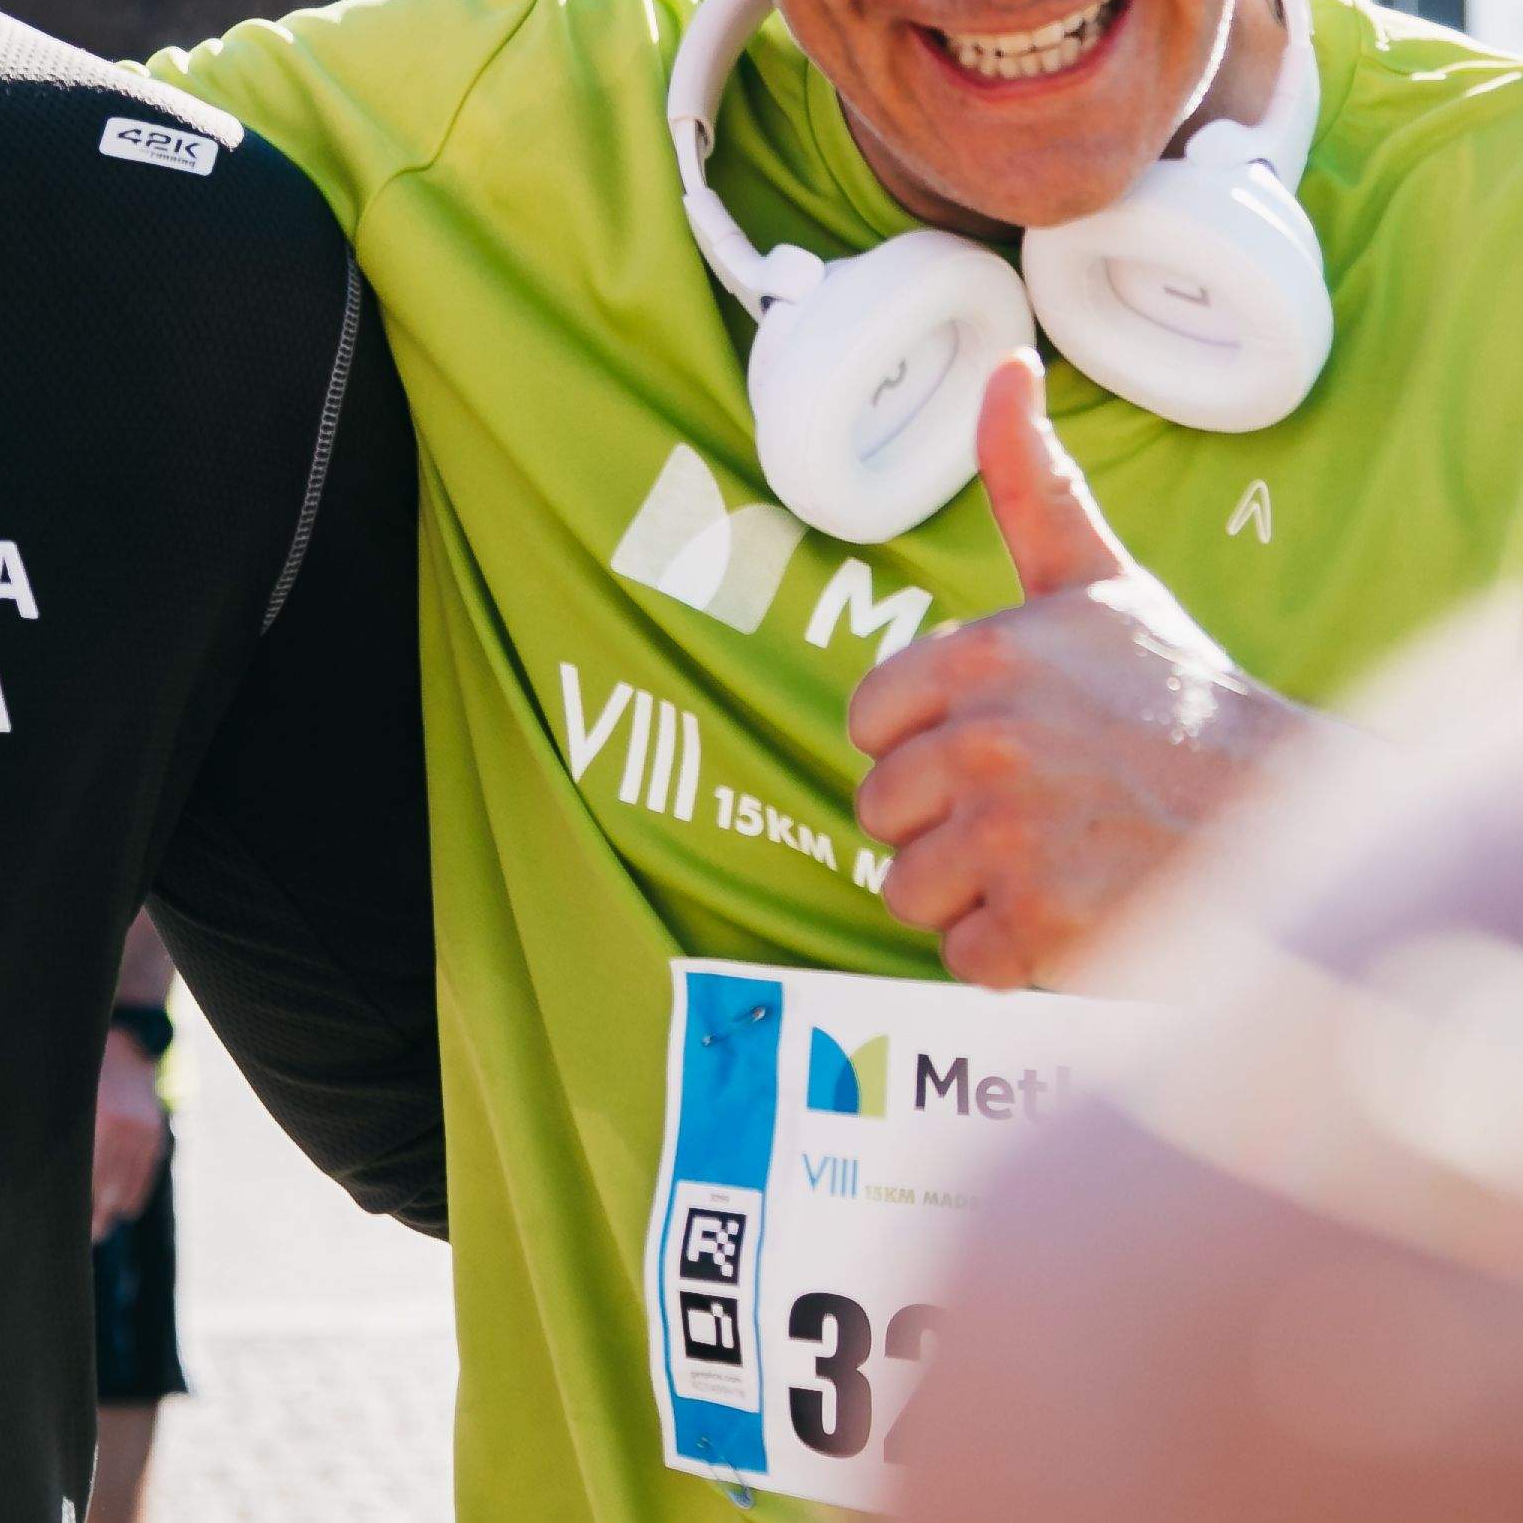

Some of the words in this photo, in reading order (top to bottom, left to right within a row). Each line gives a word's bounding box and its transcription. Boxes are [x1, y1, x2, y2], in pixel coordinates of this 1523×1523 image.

[117, 128, 200, 159] 42K
[559, 661, 701, 822] VIII
[714, 785, 838, 872] 15KM
[801, 1153, 859, 1200] VIII
